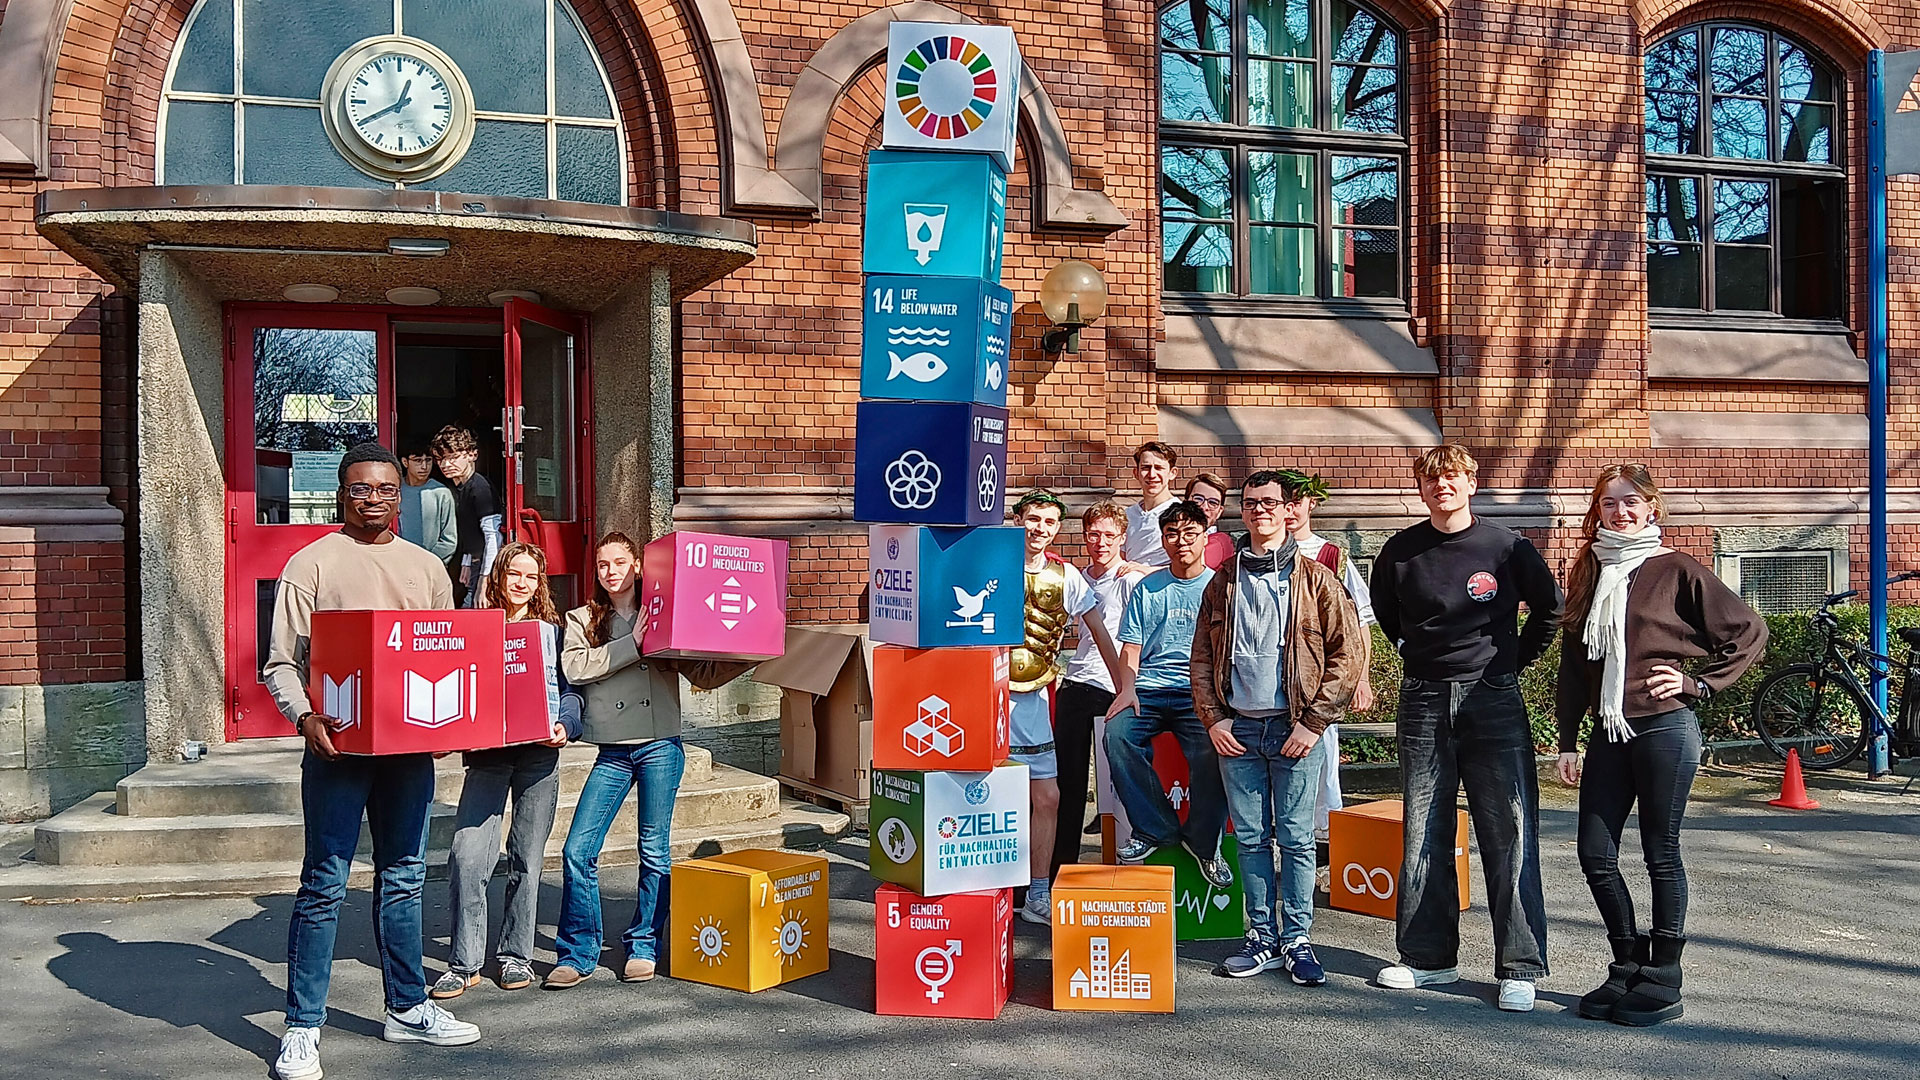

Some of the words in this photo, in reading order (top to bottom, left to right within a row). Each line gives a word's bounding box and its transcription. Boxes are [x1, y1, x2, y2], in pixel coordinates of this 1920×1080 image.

[873, 288, 894, 314] 14
[901, 289, 918, 300] LIFE
[900, 303, 929, 315] BELOW
[930, 304, 957, 316] WATER
[984, 294, 991, 321] 14
[973, 416, 981, 442] 17
[685, 542, 707, 568] 10
[713, 544, 750, 559] REDUCED
[712, 558, 765, 573] INEQUALITIES
[875, 592, 883, 605] FÜR
[884, 595, 912, 609] NACHHALTIGE
[875, 606, 912, 622] ENTWICKLUNG
[387, 621, 403, 651] 4
[413, 621, 452, 636] QUALITY
[412, 637, 465, 651] EDUCATION
[504, 637, 527, 650] RDIGE
[504, 651, 520, 662] IRT-
[505, 662, 527, 674] STUM
[872, 769, 883, 796] 13
[939, 842, 956, 856] FÜR
[960, 838, 1018, 853] NACHHALTIGE
[939, 850, 1018, 869] ENTWICKLUNG
[774, 873, 809, 891] AFFORDABLE
[809, 870, 821, 882] AND
[760, 882, 768, 908] 7
[773, 889, 792, 904] CLEAN
[792, 885, 814, 899] ENERGY
[910, 903, 943, 916] GENDER
[1057, 899, 1075, 925] 11
[1081, 901, 1136, 913] NACHHALTIGE
[1137, 899, 1167, 914] STÄDTE
[888, 902, 900, 928] 5
[1081, 915, 1100, 926] UND
[1102, 915, 1151, 927] GEMEINDEN
[910, 917, 950, 930] EQUALITY
